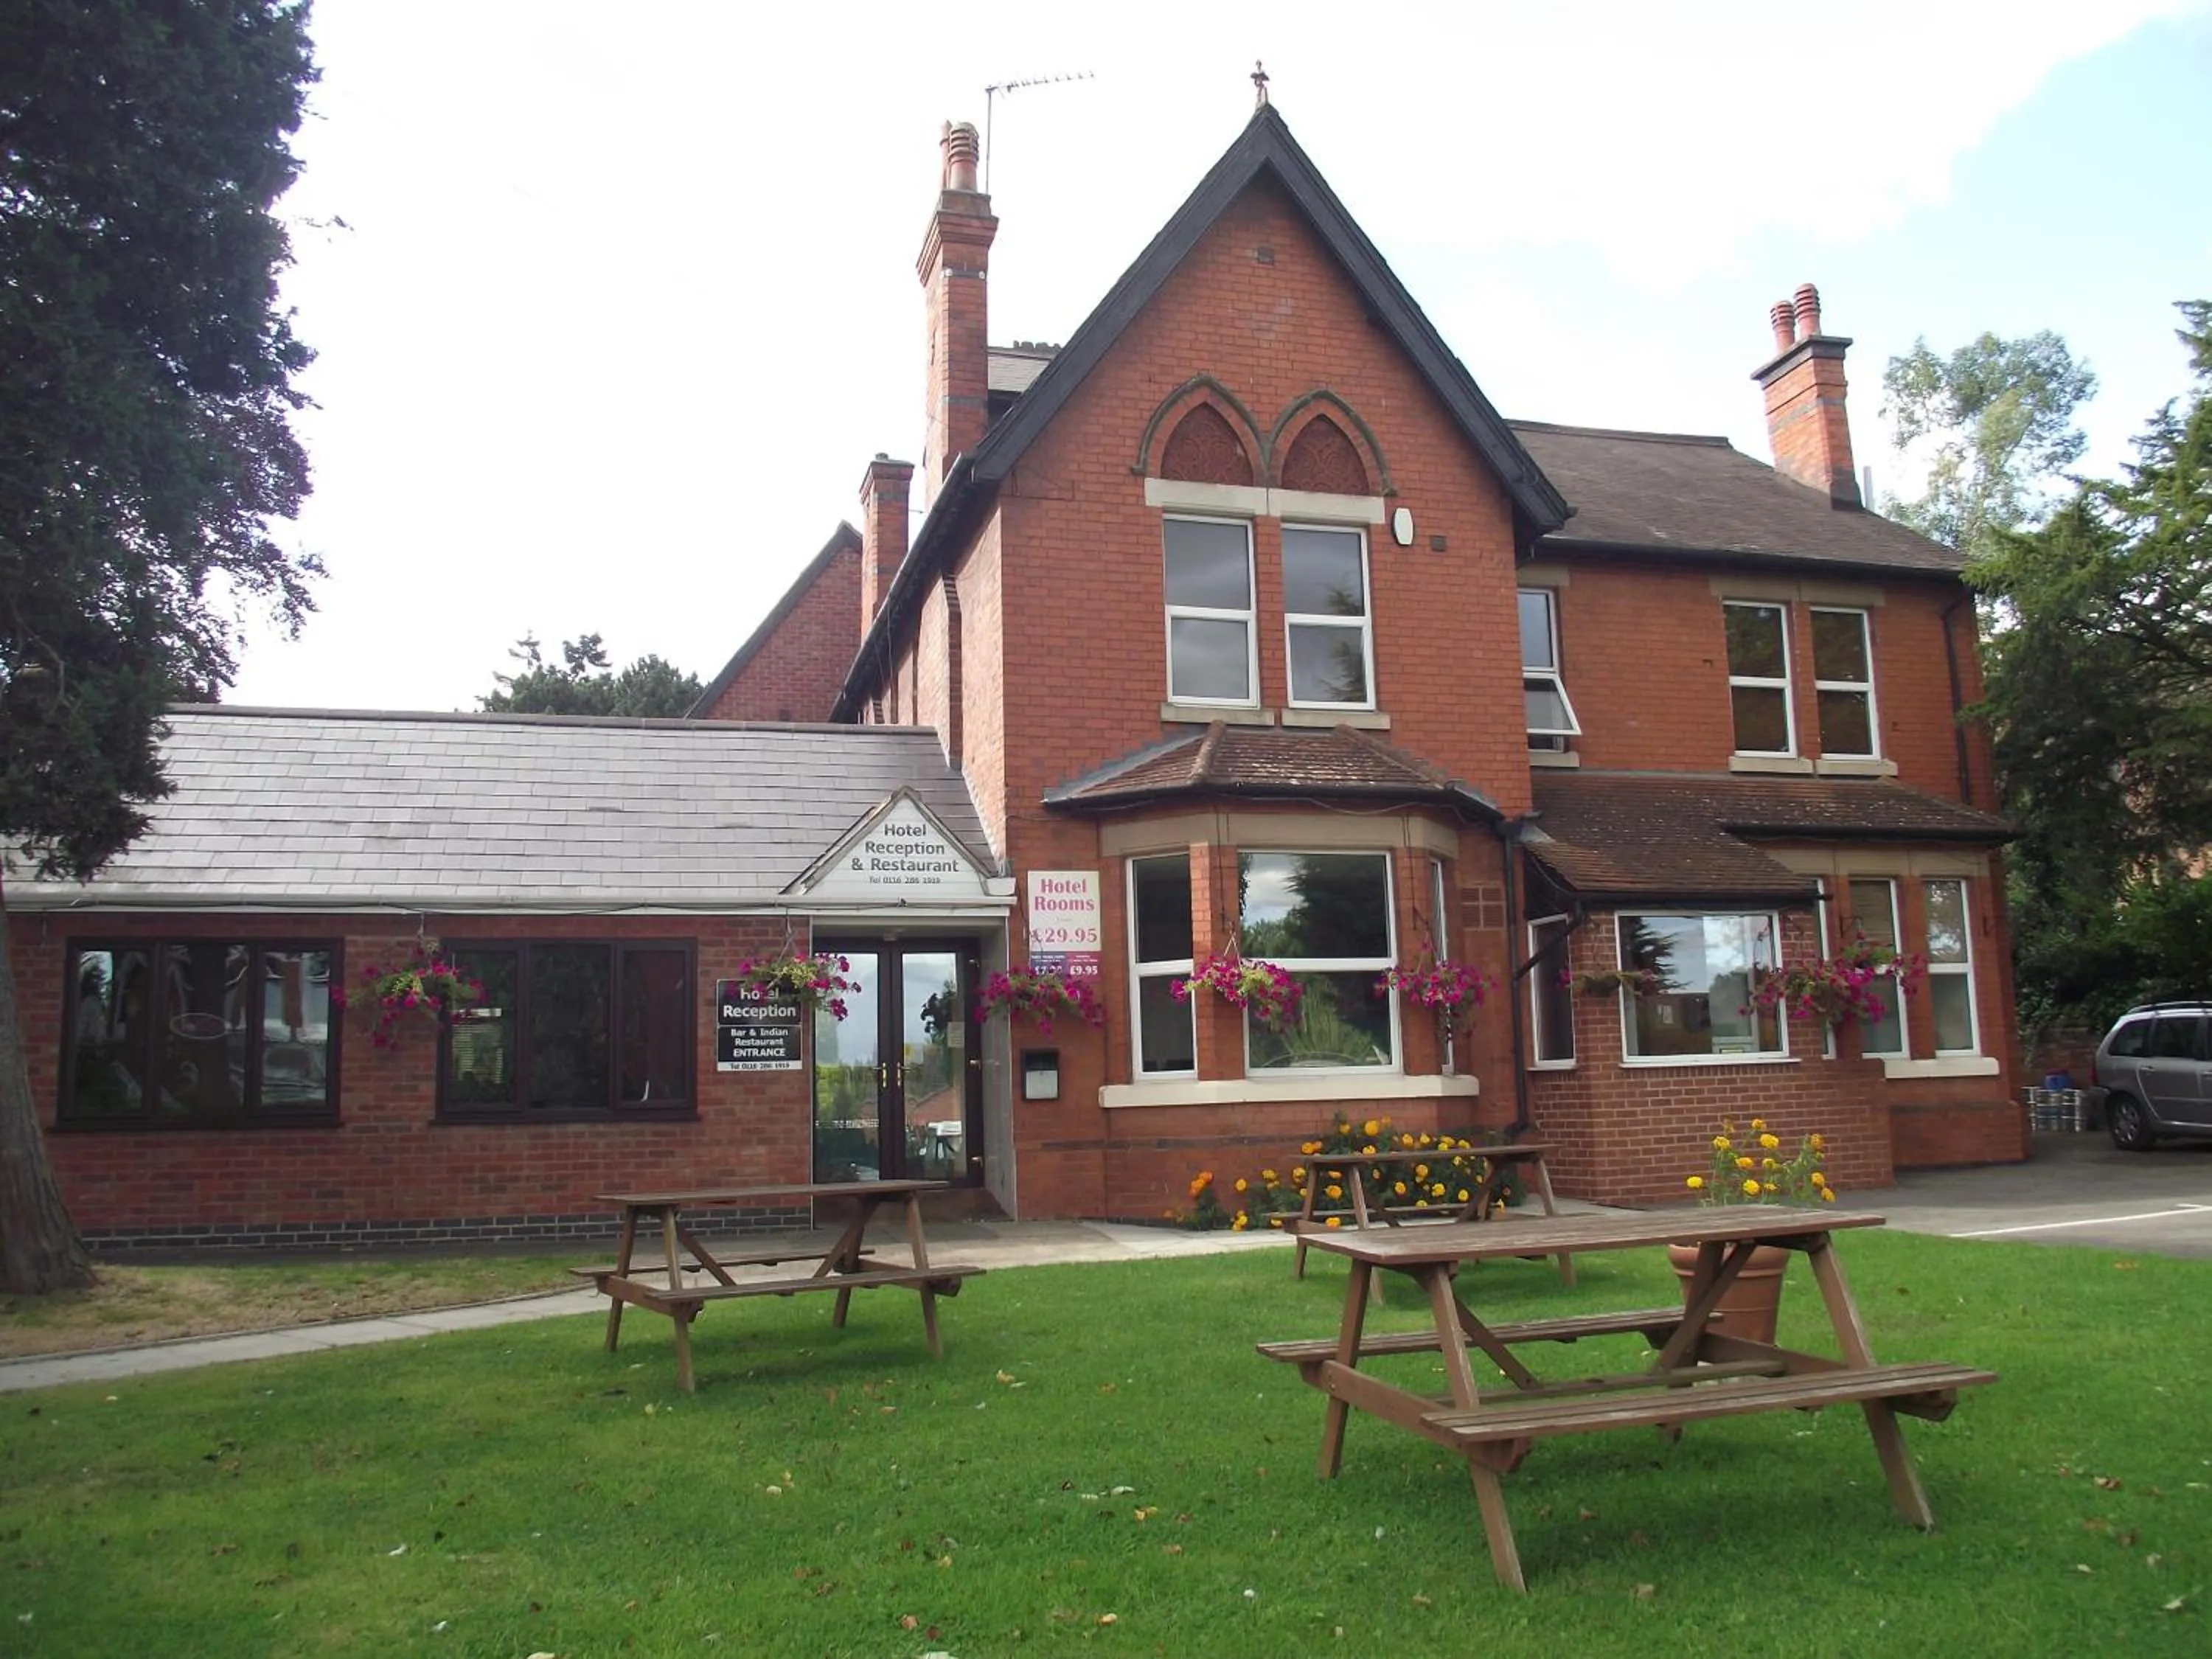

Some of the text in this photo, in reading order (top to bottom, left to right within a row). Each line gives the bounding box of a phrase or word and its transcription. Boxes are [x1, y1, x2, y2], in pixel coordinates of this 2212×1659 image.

[884, 824, 926, 837] Hotel
[865, 841, 945, 857] Reception
[852, 858, 959, 872] & Restaurant
[869, 876, 881, 884] Tel
[1040, 878, 1087, 894] Hotel
[1034, 896, 1095, 911] Rooms
[1032, 928, 1098, 943] £29.95
[740, 987, 779, 1001] Hoel
[723, 1005, 796, 1020] Reception
[731, 1028, 788, 1037] Bar & Indian
[734, 1037, 784, 1046] Restaurant
[733, 1048, 786, 1057] ENTRANCE
